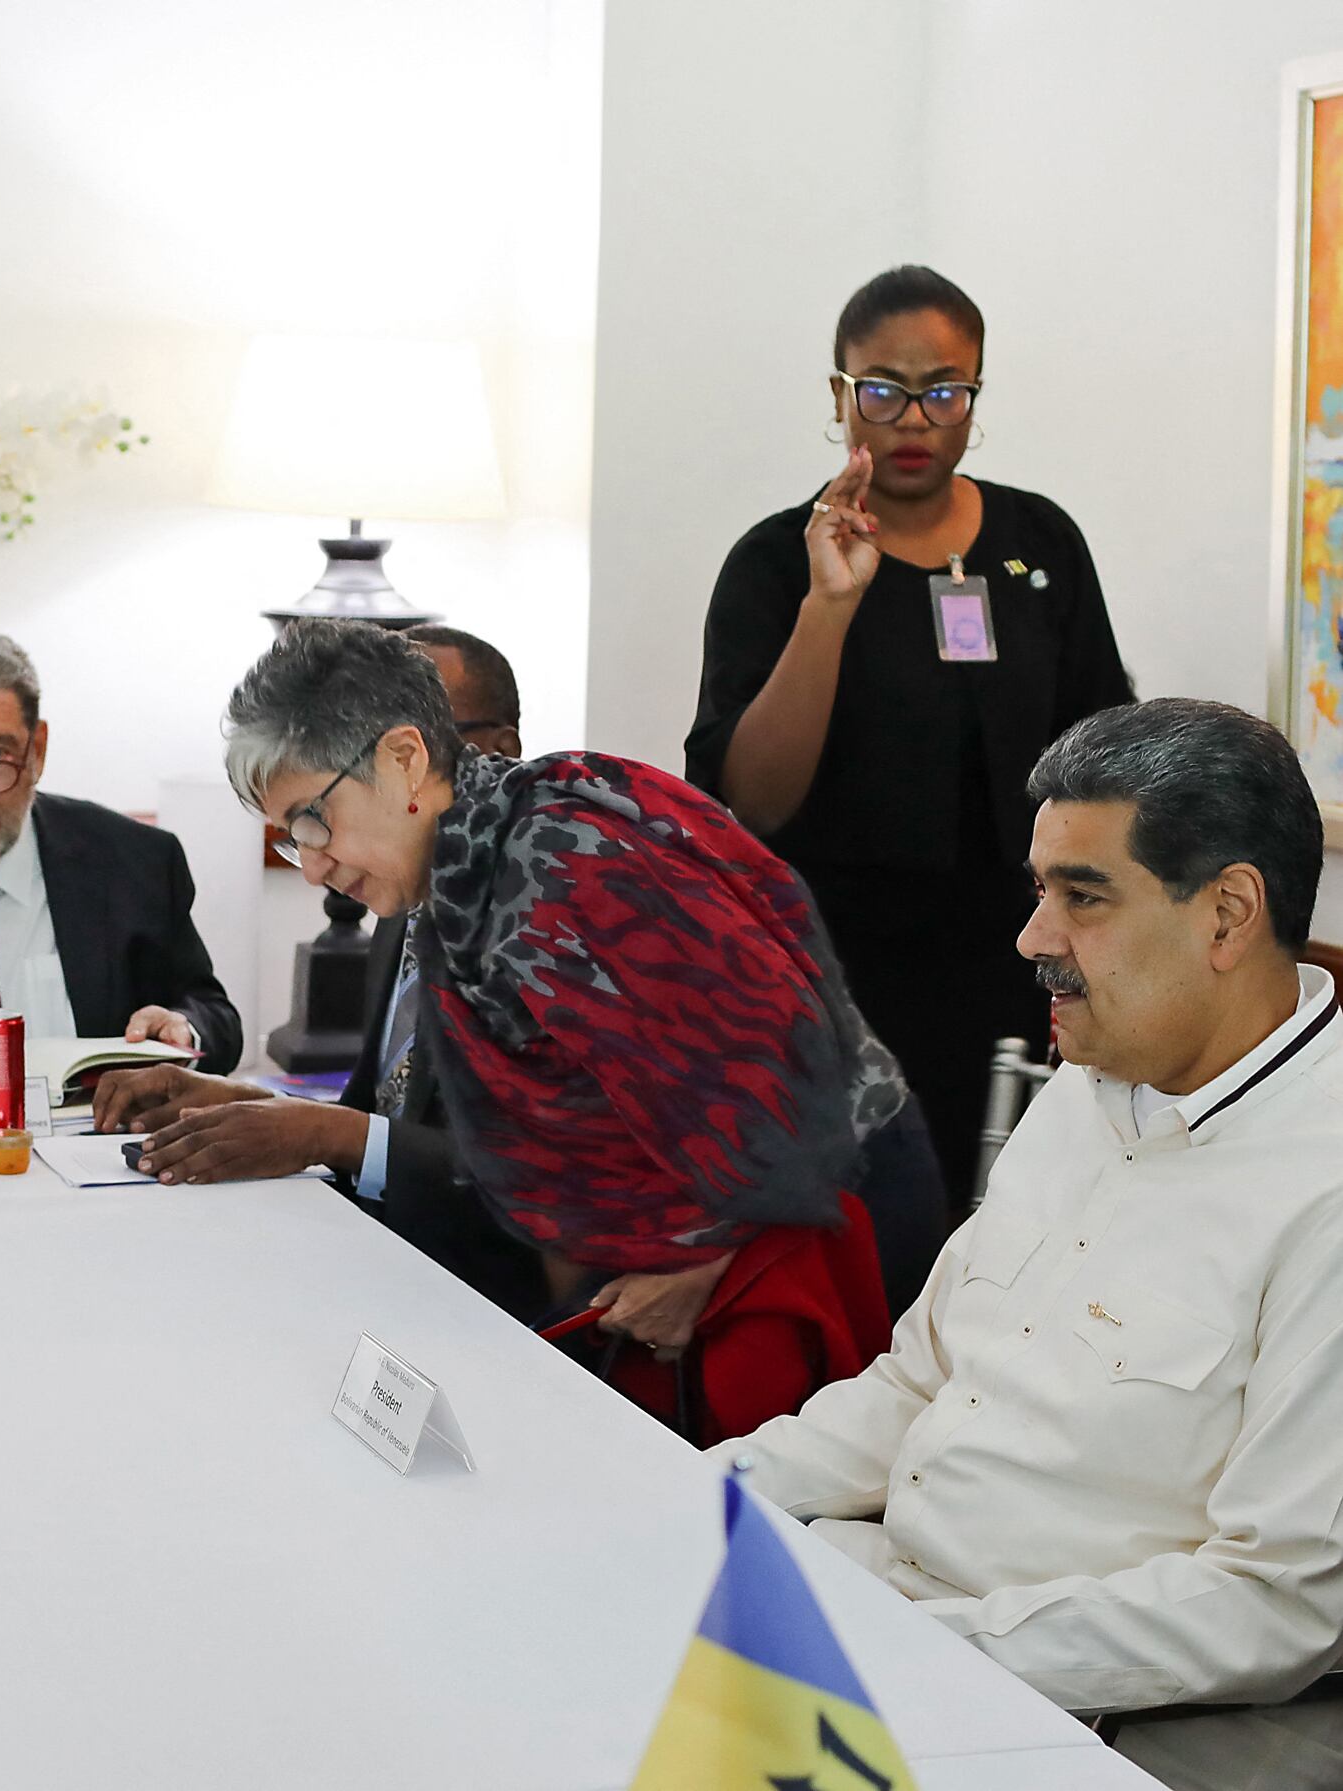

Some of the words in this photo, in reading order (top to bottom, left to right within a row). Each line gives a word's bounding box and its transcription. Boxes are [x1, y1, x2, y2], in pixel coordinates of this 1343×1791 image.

[371, 1380, 402, 1415] President
[361, 1408, 383, 1433] Republic
[380, 1426, 389, 1437] of
[387, 1429, 410, 1457] Venezuela
